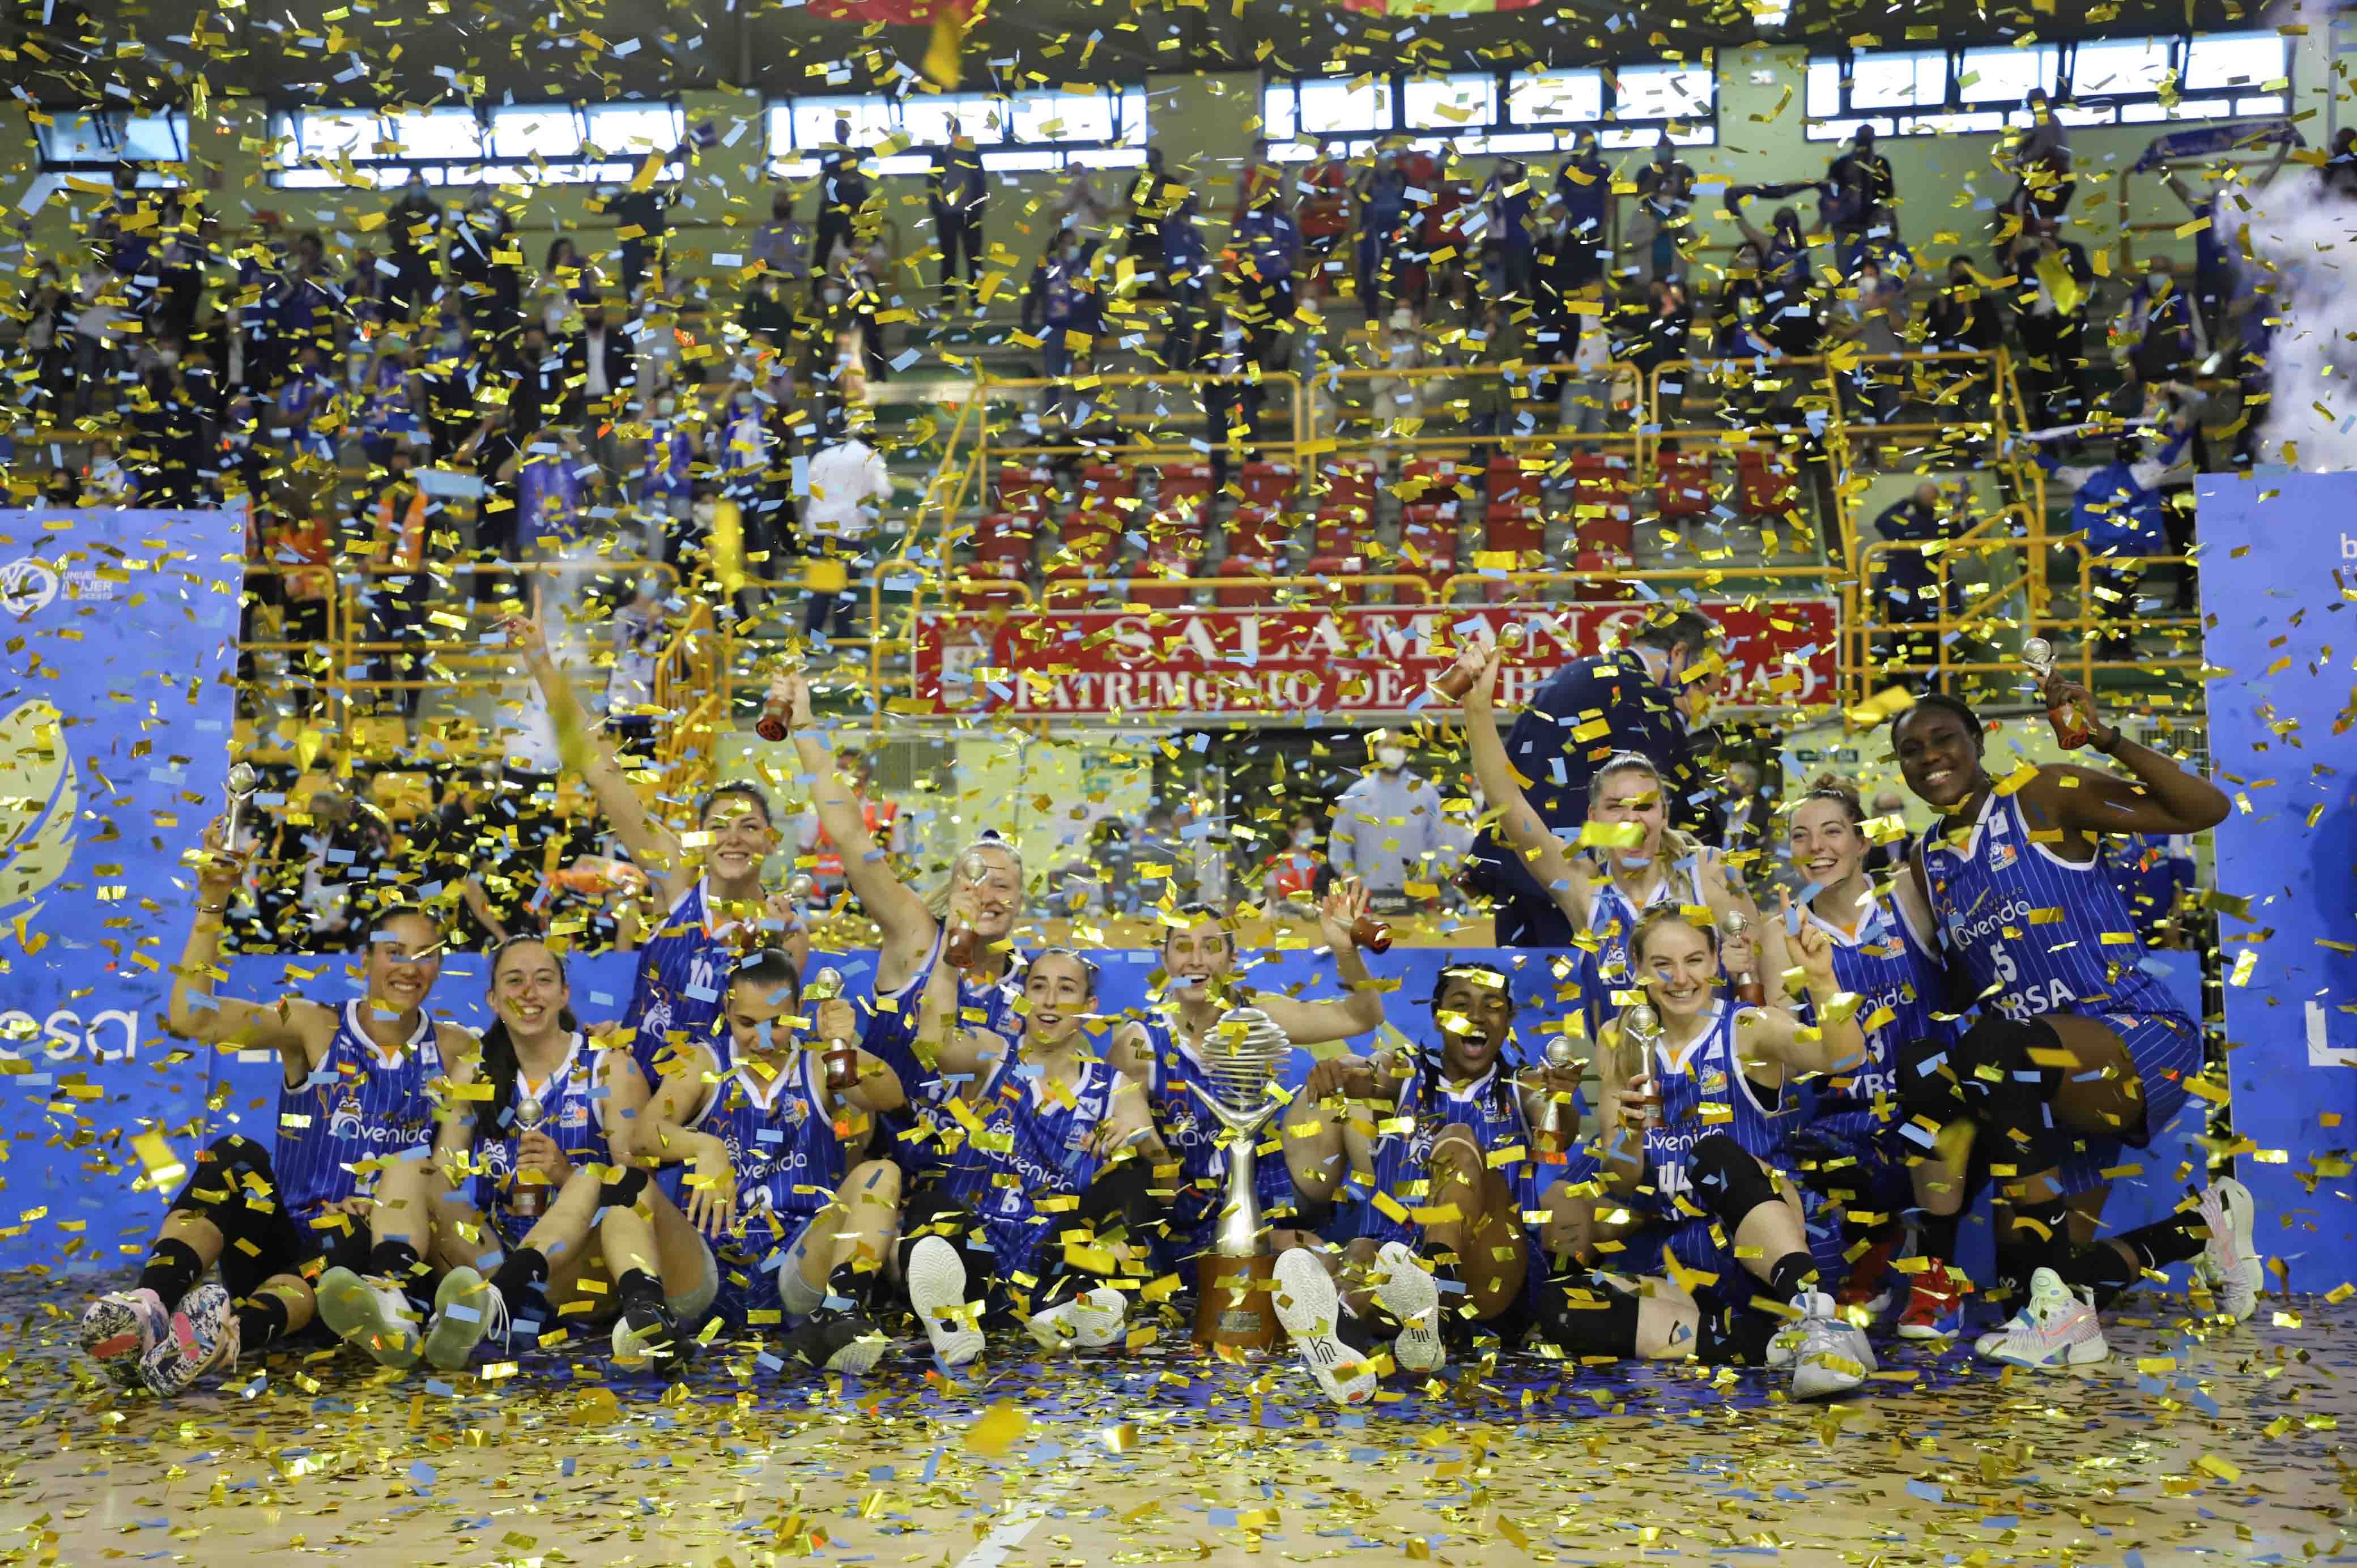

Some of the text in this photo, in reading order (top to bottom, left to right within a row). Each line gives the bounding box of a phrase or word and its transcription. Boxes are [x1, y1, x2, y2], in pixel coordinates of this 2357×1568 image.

[1112, 610, 1647, 663] SALAMANC
[1336, 667, 1407, 706] DE
[1990, 939, 2017, 982] 5
